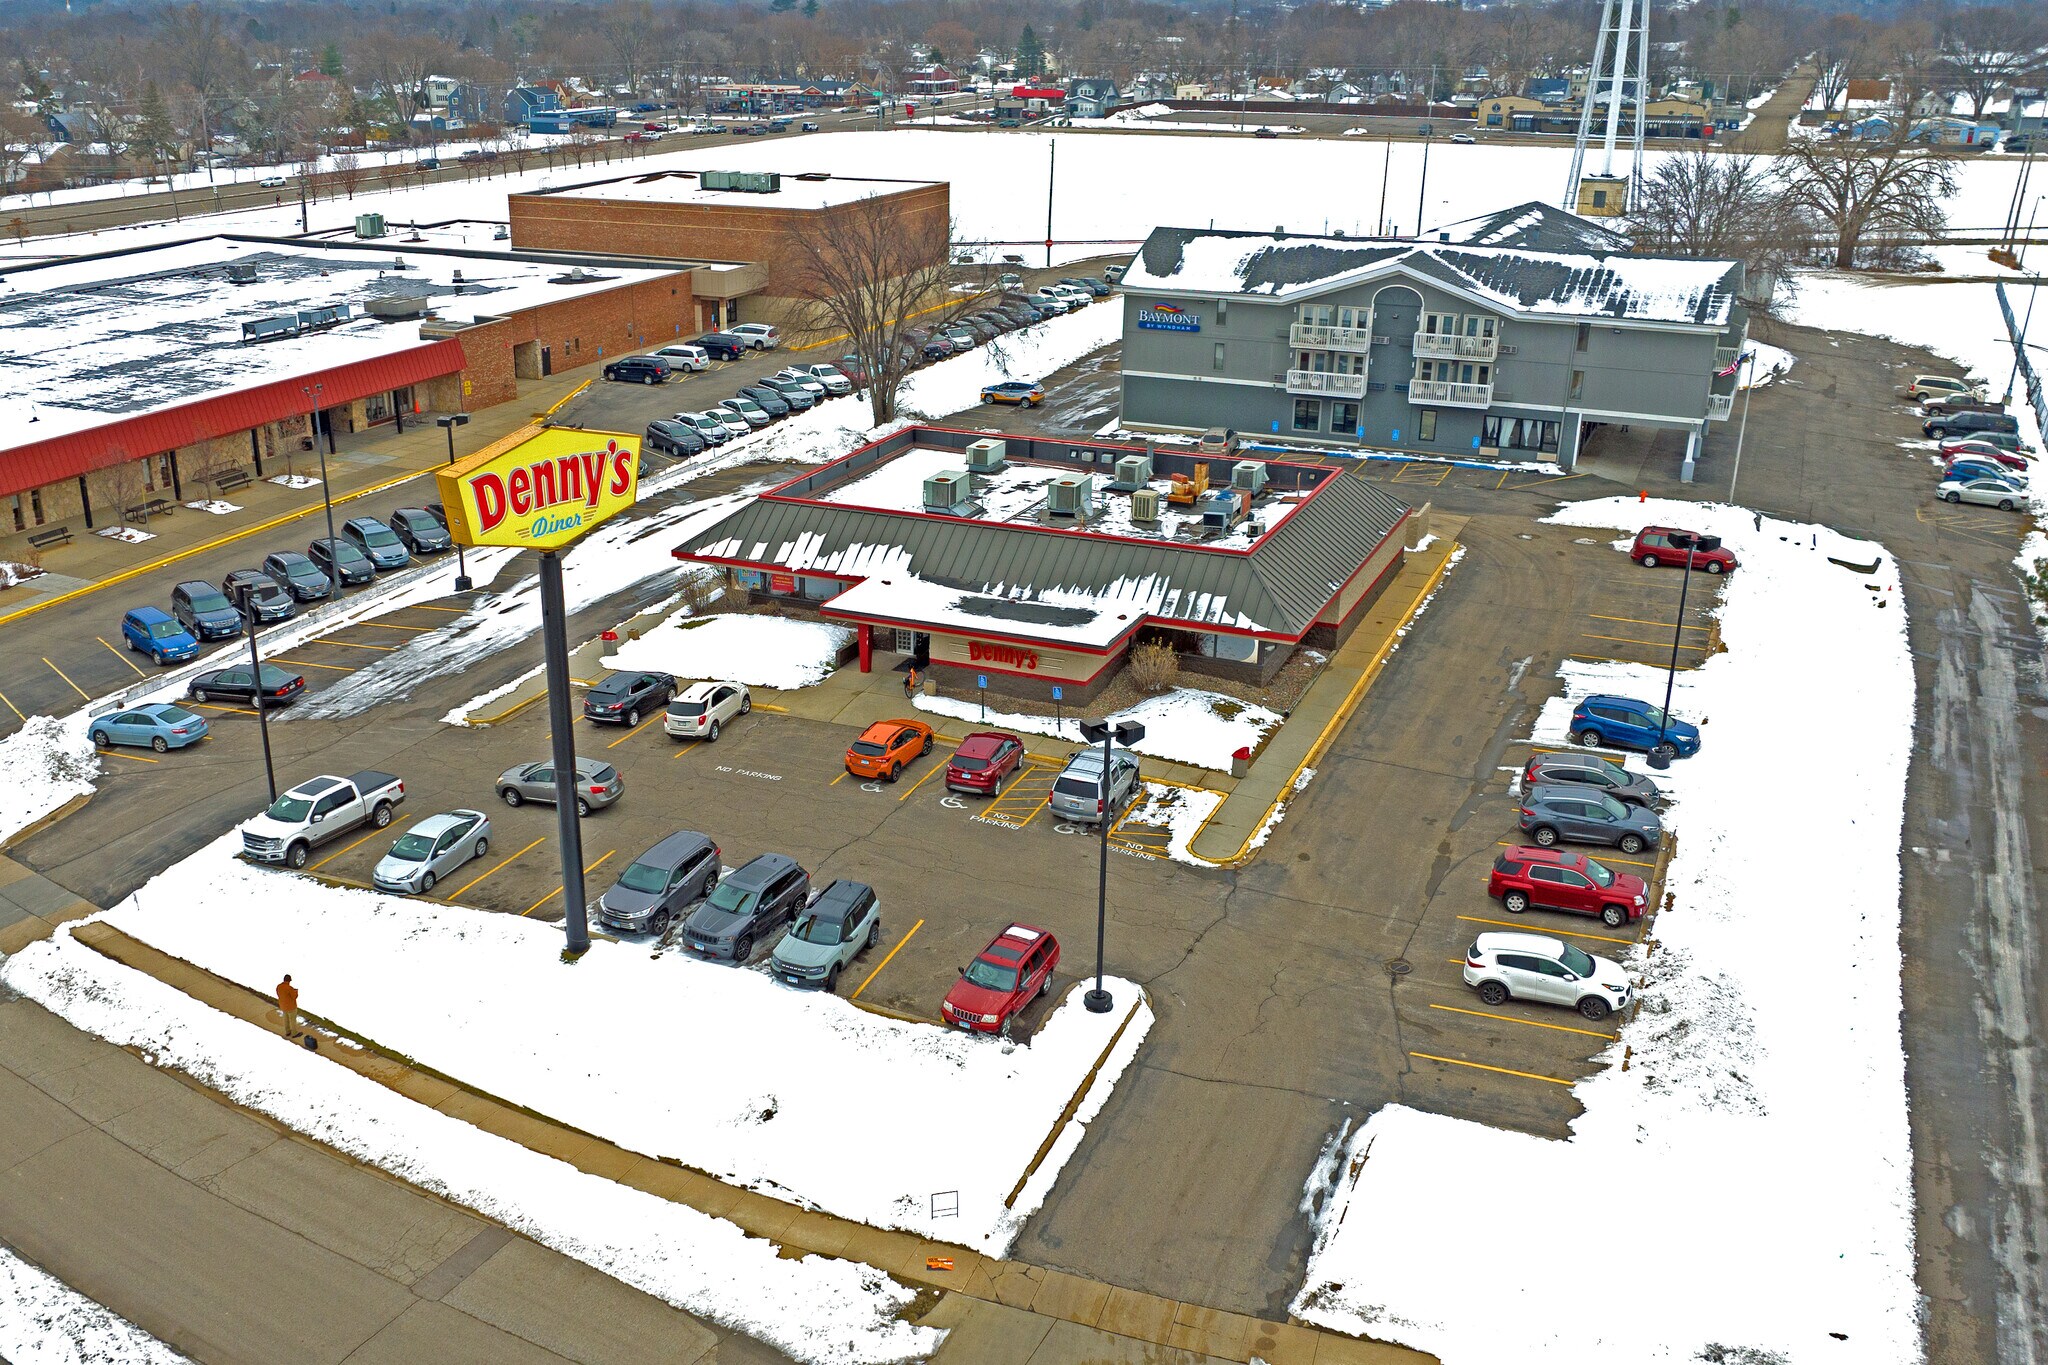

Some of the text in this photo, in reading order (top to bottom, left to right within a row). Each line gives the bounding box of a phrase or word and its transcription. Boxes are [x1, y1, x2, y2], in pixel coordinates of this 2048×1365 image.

[1139, 310, 1199, 324] BAYMONT
[468, 438, 633, 536] Denny's
[531, 513, 582, 538] Diner
[968, 641, 1039, 670] Denny's
[735, 769, 783, 781] PARKING
[969, 815, 1021, 830] PARKING
[993, 813, 1010, 821] NO
[1125, 842, 1144, 850] NO
